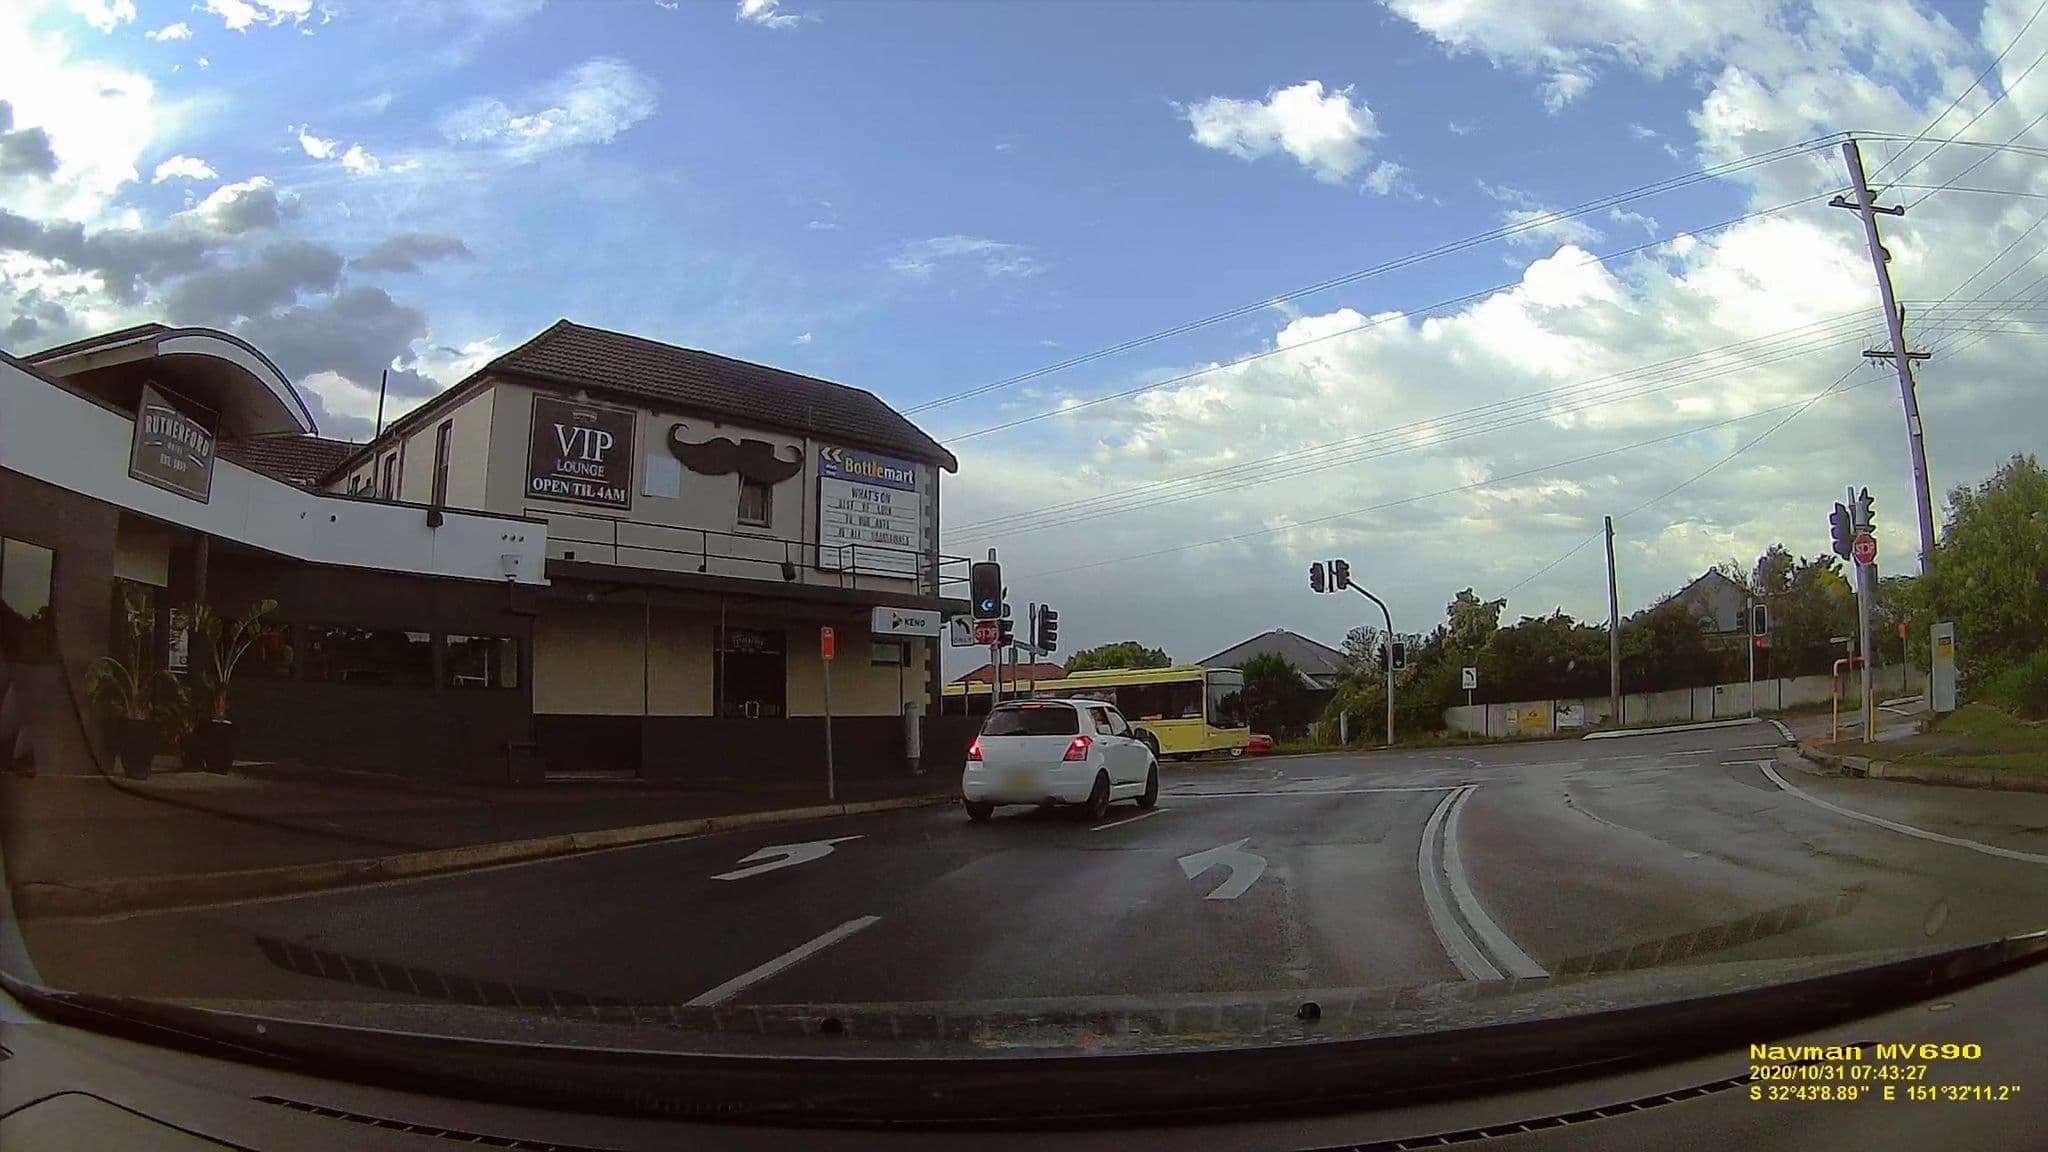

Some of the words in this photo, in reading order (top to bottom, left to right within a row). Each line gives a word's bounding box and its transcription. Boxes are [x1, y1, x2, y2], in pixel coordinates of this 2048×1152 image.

[145, 415, 210, 457] RUTHERFORD
[554, 423, 613, 462] VIP
[556, 459, 605, 477] LOUNGE
[845, 456, 914, 484] Bottlemart
[532, 477, 570, 494] OPEN
[572, 483, 595, 498] TIL
[597, 486, 625, 502] 4AM
[905, 618, 926, 627] KENO
[975, 627, 998, 639] STOP
